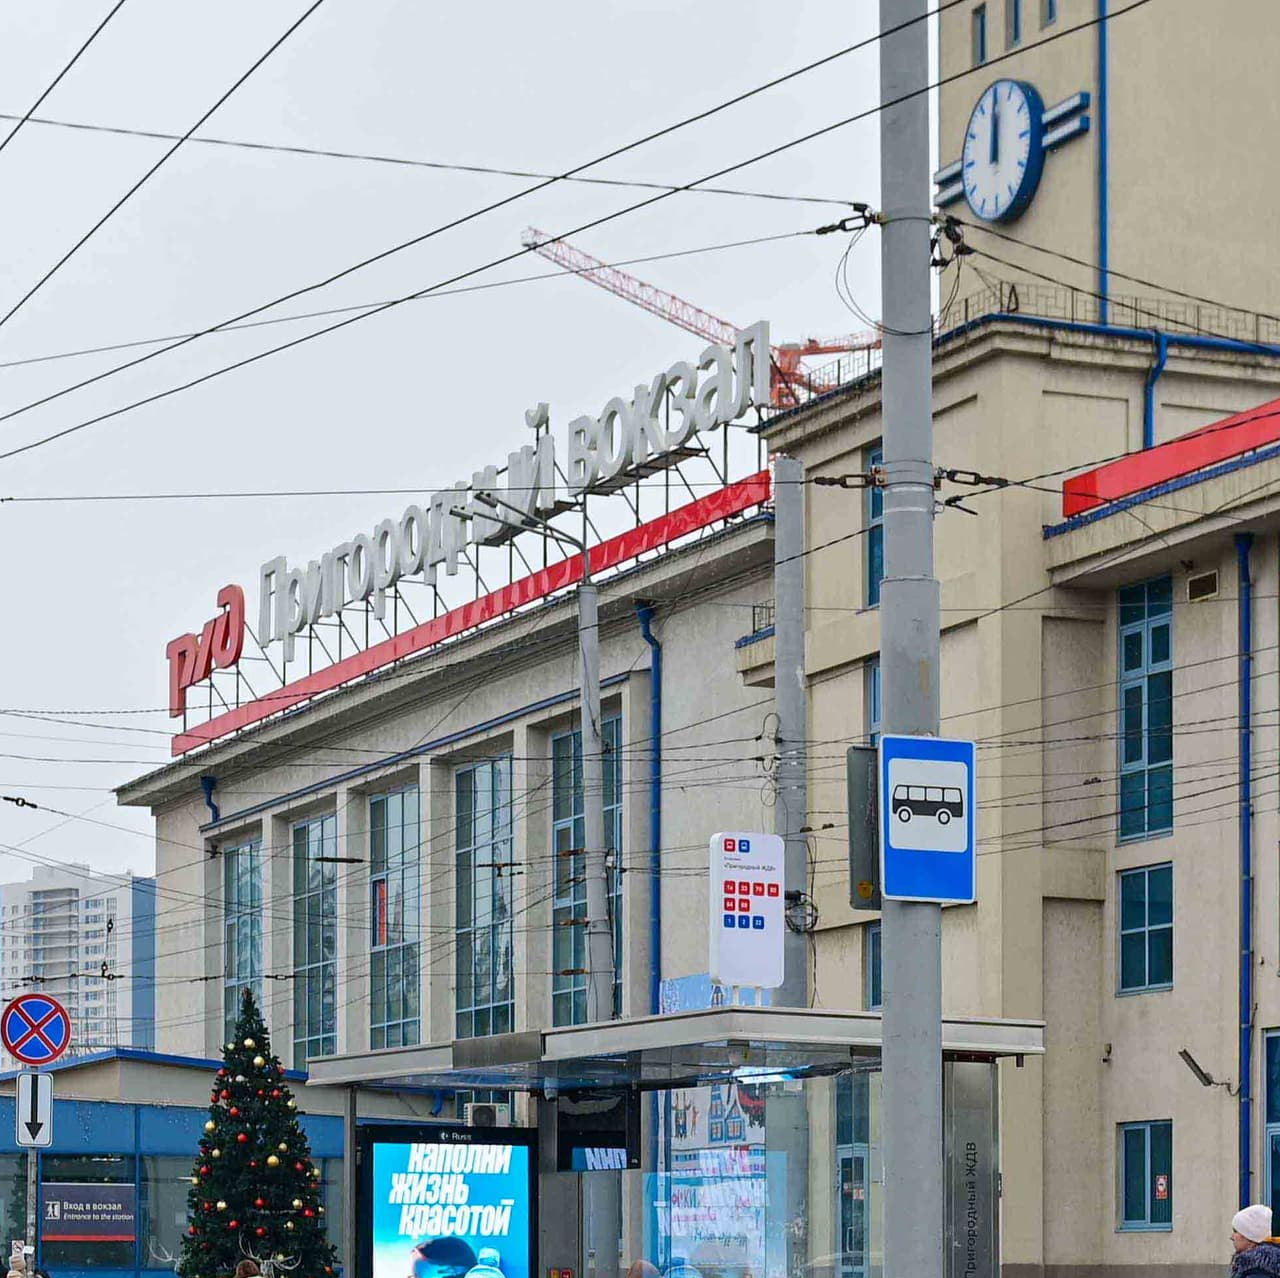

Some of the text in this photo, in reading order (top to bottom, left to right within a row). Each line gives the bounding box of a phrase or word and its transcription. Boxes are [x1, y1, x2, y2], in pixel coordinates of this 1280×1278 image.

[258, 402, 556, 662] Пригородный
[568, 320, 770, 497] вокзал
[965, 1142, 978, 1177] ЖДВ
[63, 1201, 84, 1211] Вход
